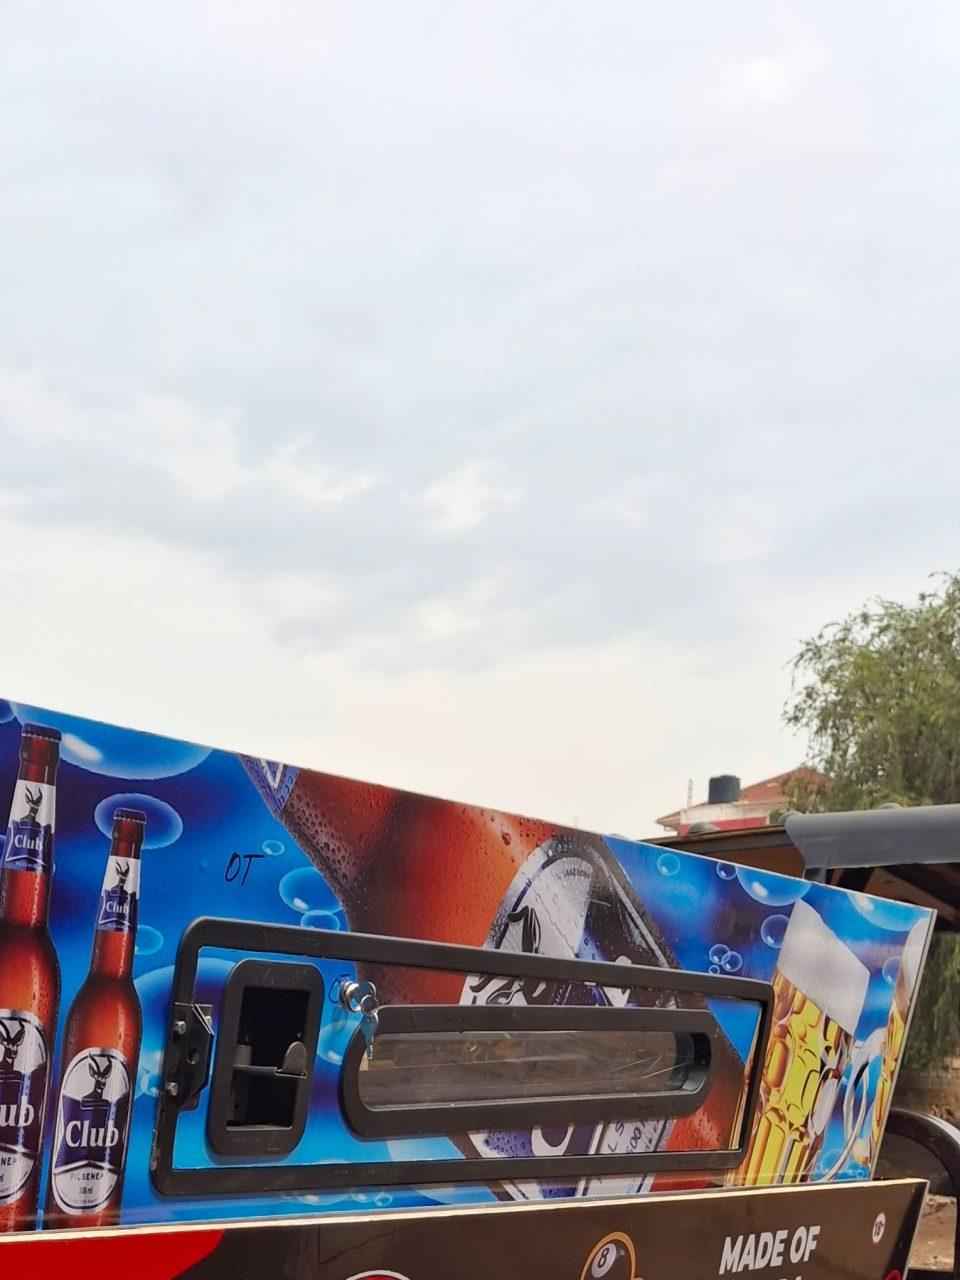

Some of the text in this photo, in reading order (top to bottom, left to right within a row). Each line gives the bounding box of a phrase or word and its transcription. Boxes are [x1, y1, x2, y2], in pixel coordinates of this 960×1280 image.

[15, 834, 43, 850] Club
[65, 1120, 119, 1148] Club
[597, 1248, 609, 1268] 8
[719, 1225, 821, 1275] MADE OF
